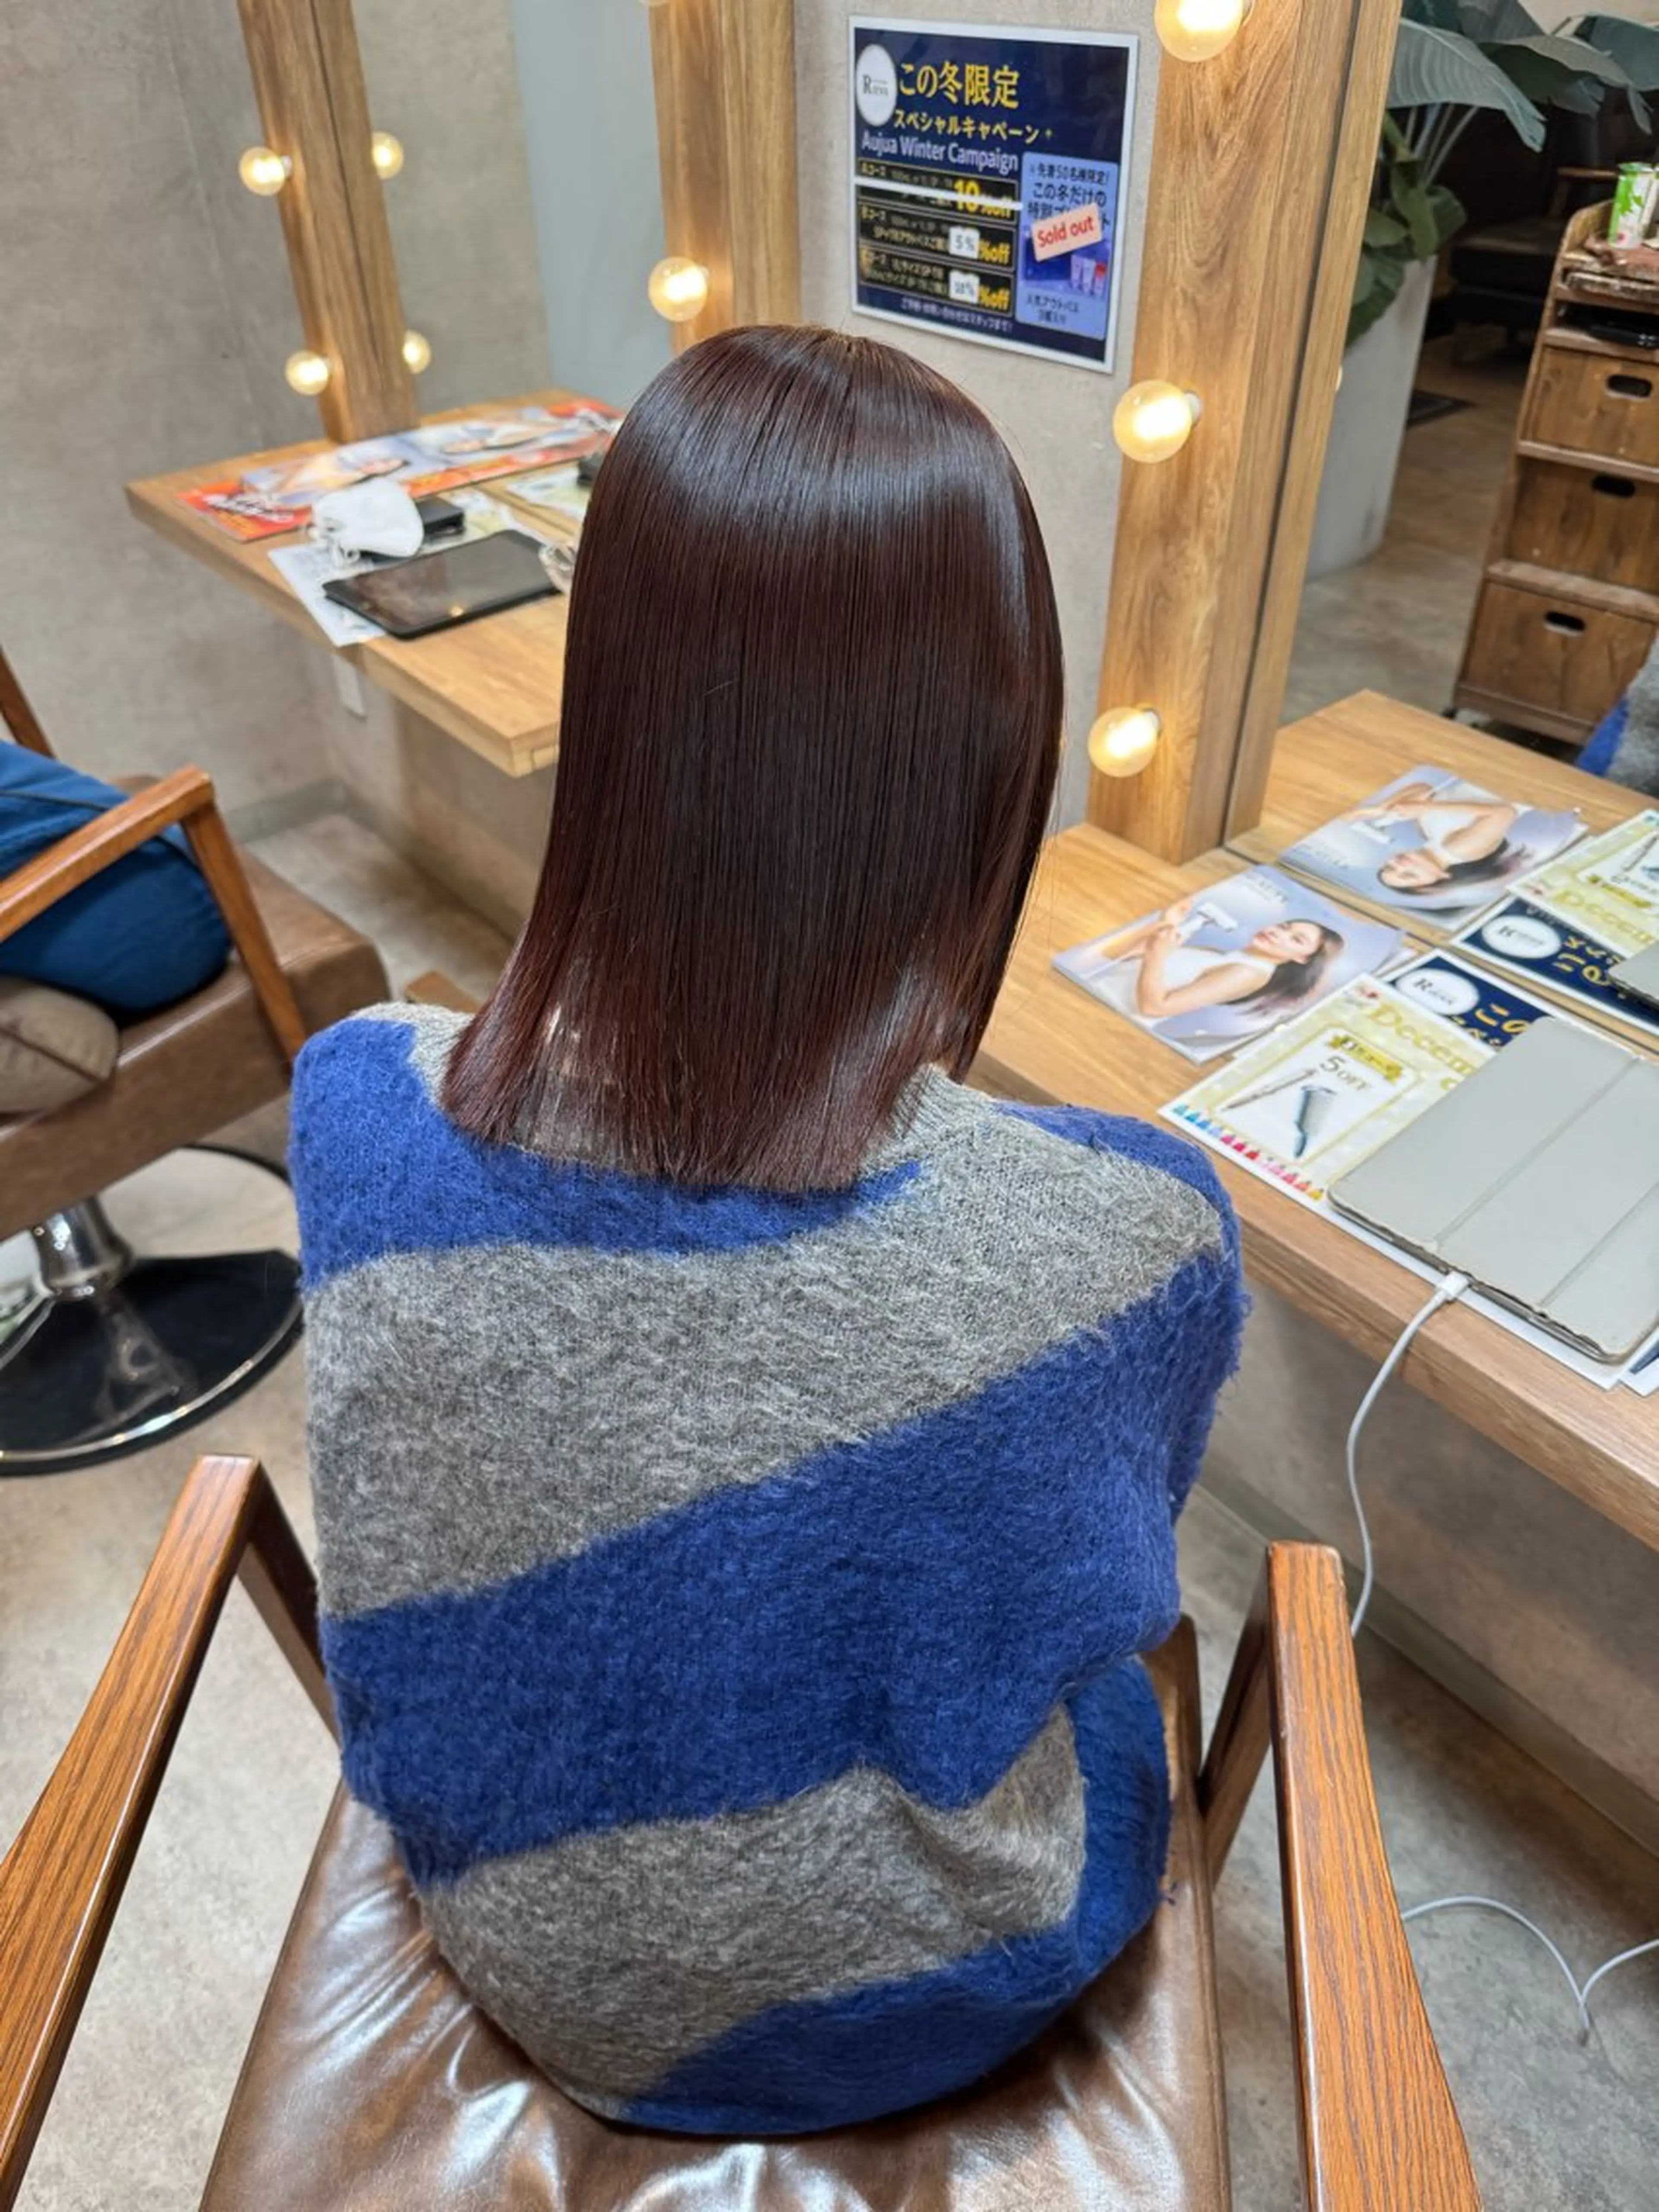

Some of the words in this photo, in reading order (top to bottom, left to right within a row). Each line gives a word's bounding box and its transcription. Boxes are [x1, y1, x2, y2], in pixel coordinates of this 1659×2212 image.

[900, 60, 1020, 109] この冬限定
[862, 132, 898, 156] Aujua
[899, 135, 946, 161] Winter
[948, 143, 1019, 176] Campaign
[953, 178, 980, 212] 10
[1033, 182, 1107, 208] この冬だけの
[1037, 222, 1067, 248] Sold
[1070, 216, 1093, 236] out
